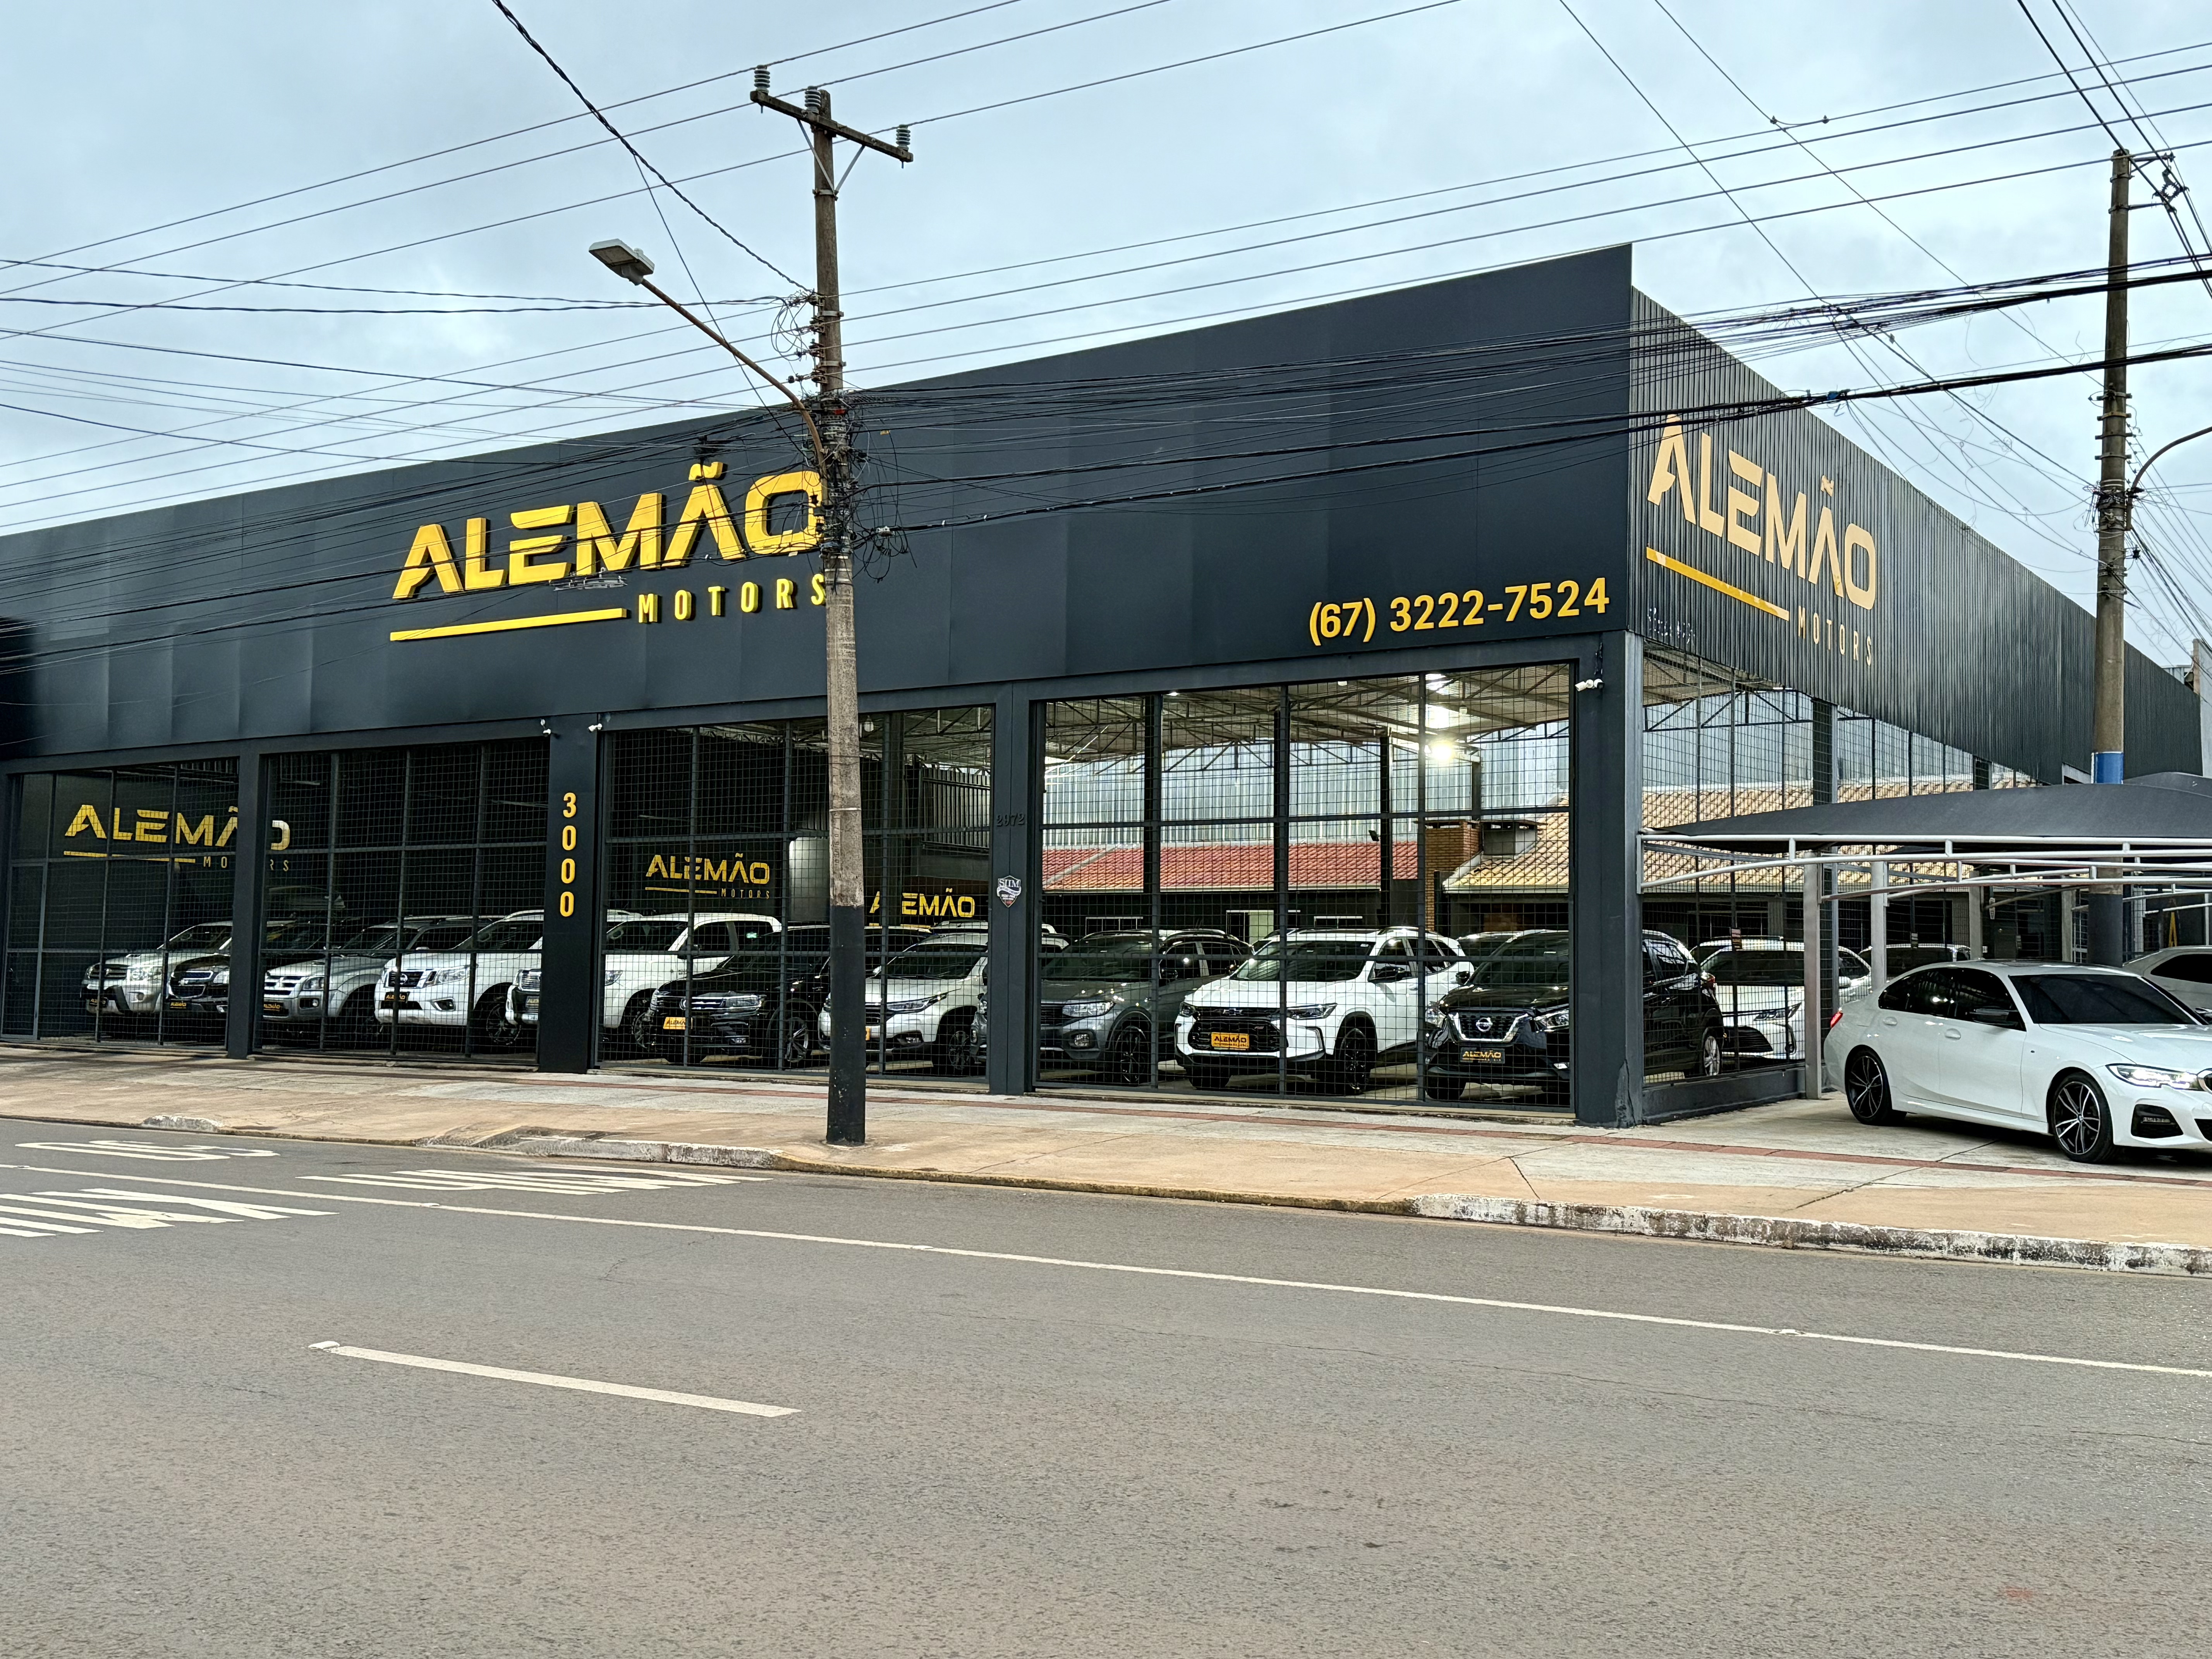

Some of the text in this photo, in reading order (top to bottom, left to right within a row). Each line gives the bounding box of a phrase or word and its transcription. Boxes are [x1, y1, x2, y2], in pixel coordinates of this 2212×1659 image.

[392, 461, 824, 599] ALEMÃO
[1647, 414, 1875, 610] ALEMÃO
[639, 574, 826, 623] MOTORS
[1309, 598, 1376, 646] (67)
[1390, 577, 1610, 632] 3222-7524
[1798, 606, 1872, 666] MOTORS
[996, 813, 1025, 827] 2972
[560, 792, 577, 917] 3000
[646, 852, 770, 884] ALEMÃO
[721, 888, 769, 899] MOTORS
[869, 888, 975, 918] AEMÃO
[1214, 1034, 1247, 1043] ALEMÃO
[1463, 1050, 1501, 1058] ALEMÃO
